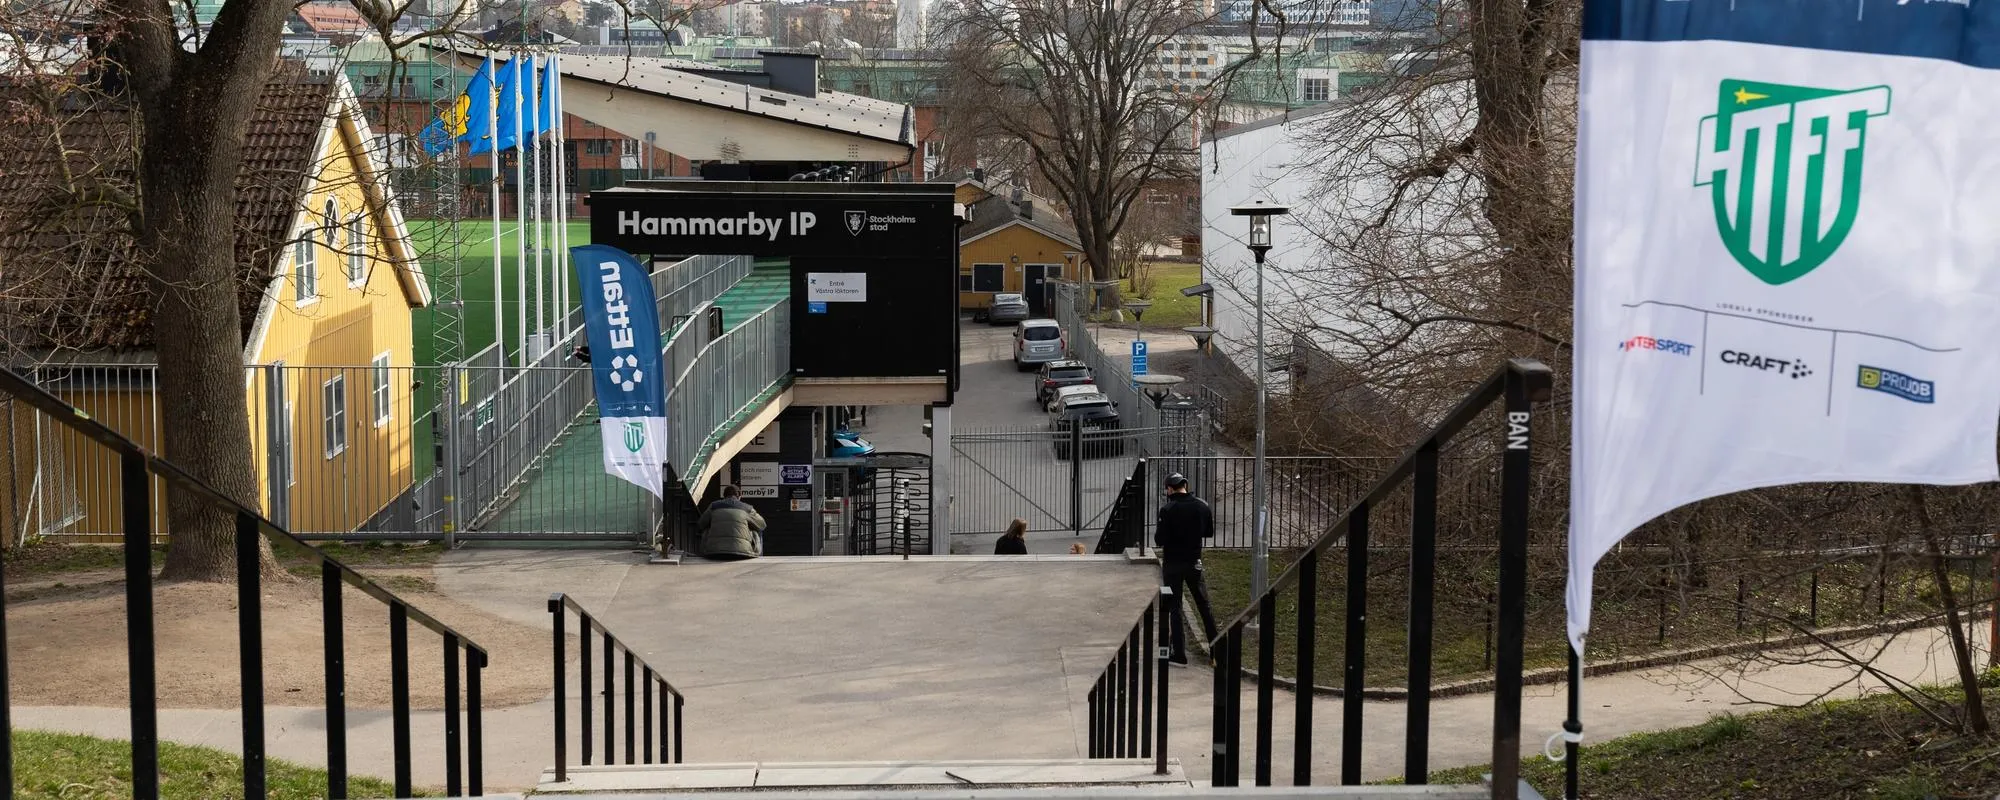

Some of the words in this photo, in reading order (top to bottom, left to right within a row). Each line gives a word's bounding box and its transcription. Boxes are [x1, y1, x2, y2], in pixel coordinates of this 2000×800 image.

[618, 210, 783, 241] Hammarby
[790, 211, 817, 236] IP
[869, 215, 916, 224] Stockholms
[869, 223, 888, 231] stad
[1135, 343, 1144, 355] P
[1720, 349, 1791, 375] CRAFT
[1881, 371, 1931, 396] PROJOB
[1507, 411, 1530, 450] BAN
[767, 488, 775, 496] IP
